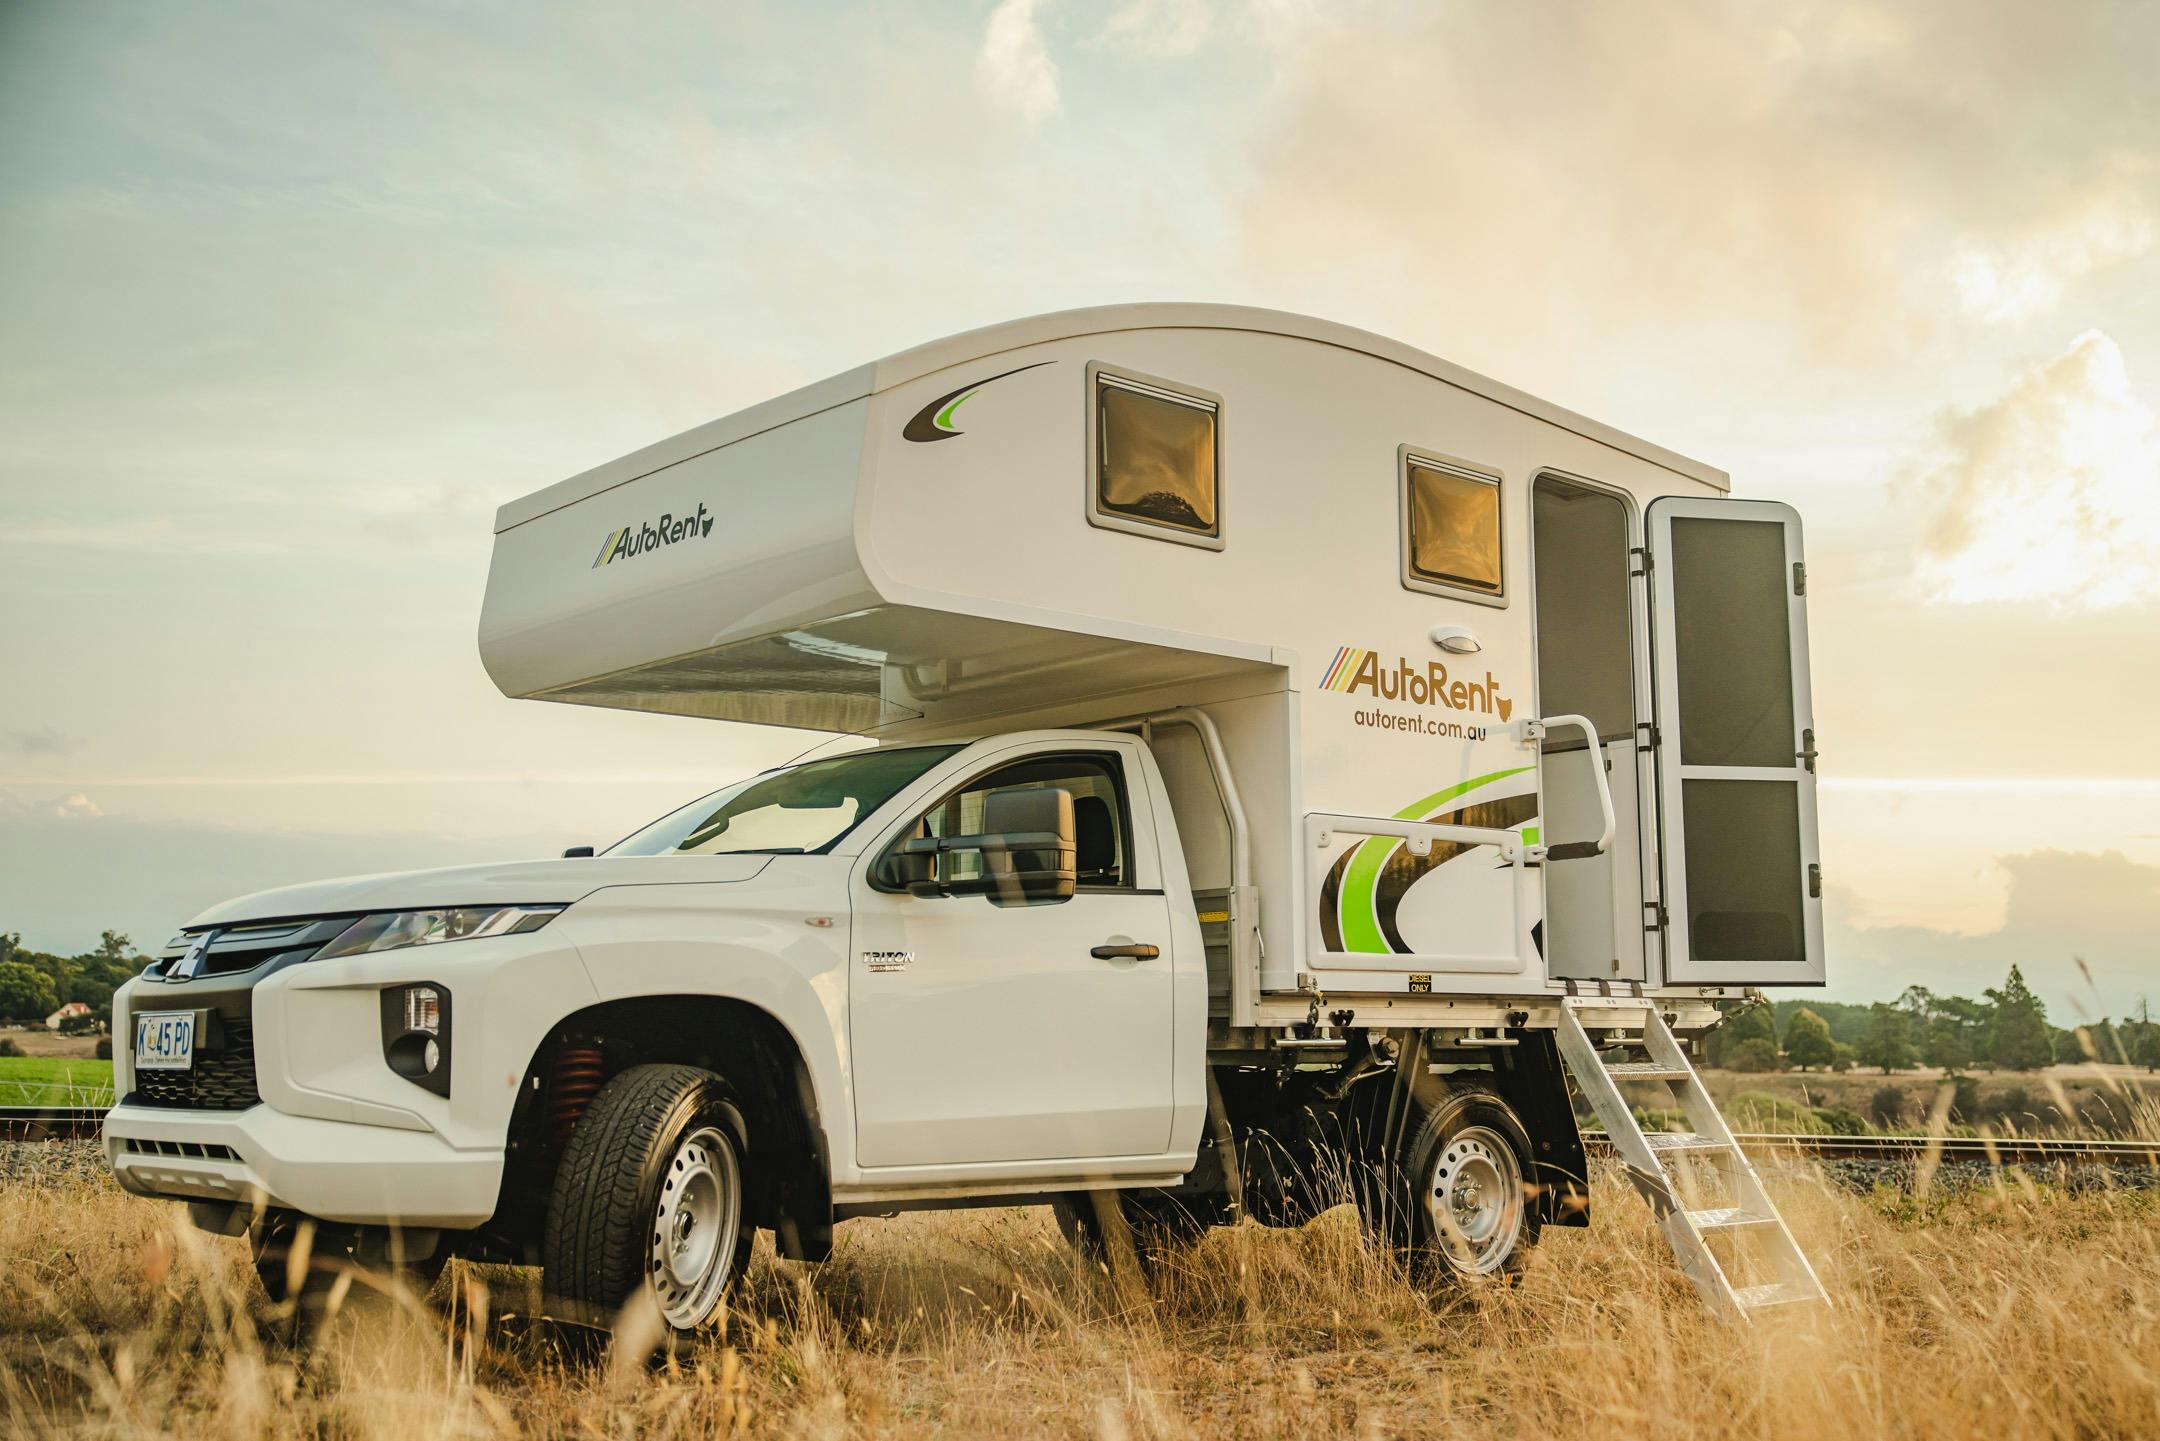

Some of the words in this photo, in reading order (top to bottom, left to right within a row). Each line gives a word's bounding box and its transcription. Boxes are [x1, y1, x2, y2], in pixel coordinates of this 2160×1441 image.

[607, 502, 707, 564] AutoRent
[1346, 650, 1500, 714] AutoRent
[1354, 708, 1486, 742] autorent.com.au
[863, 951, 915, 963] TRITON
[1411, 984, 1430, 992] ONLY
[173, 1021, 190, 1056] PD
